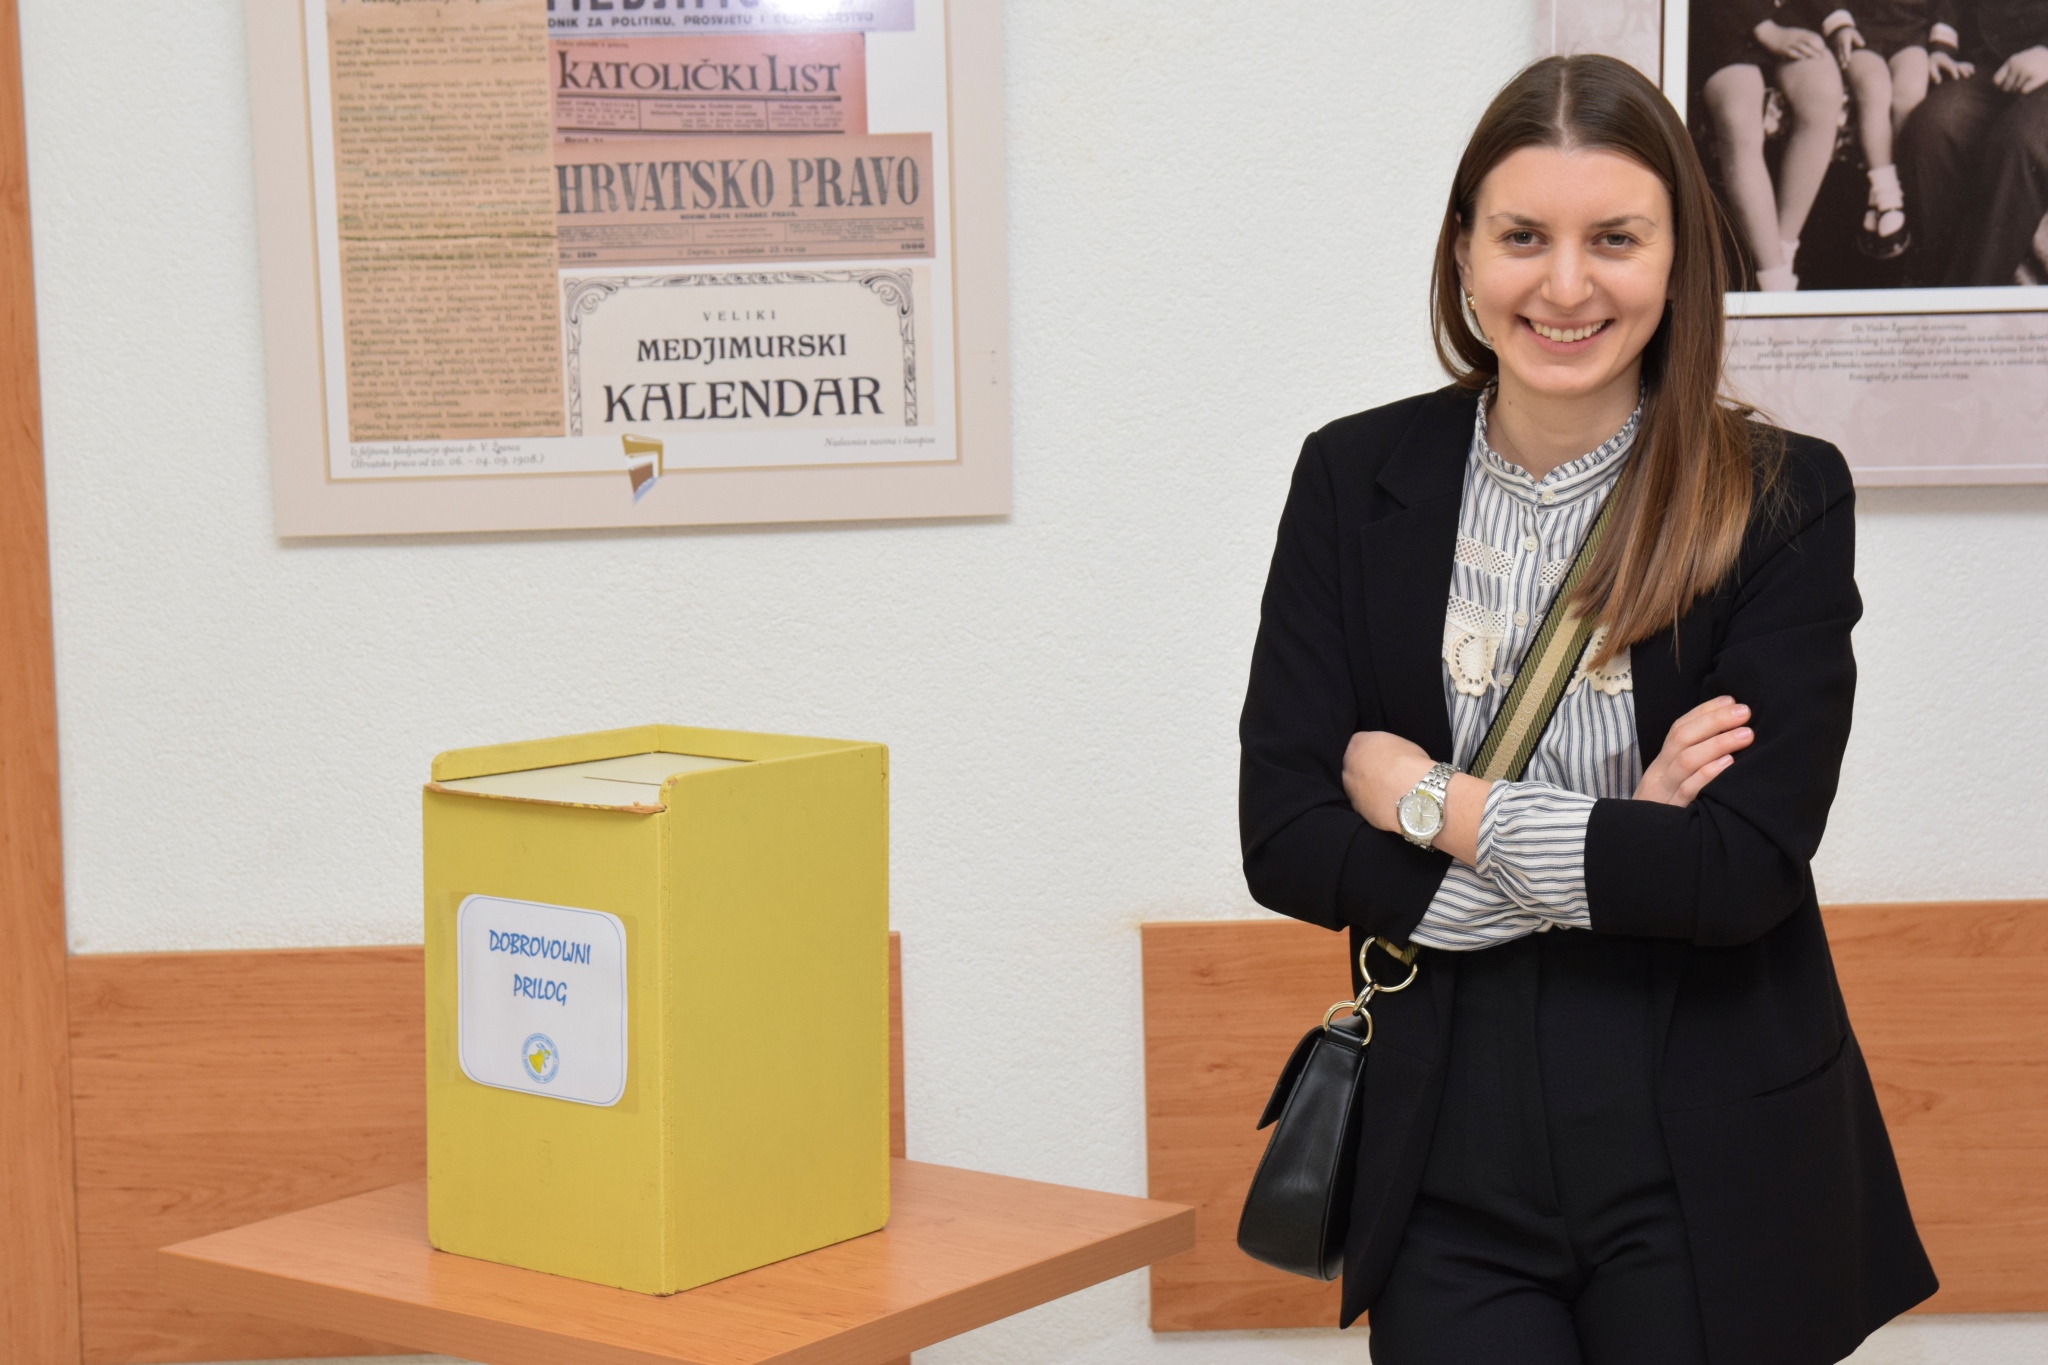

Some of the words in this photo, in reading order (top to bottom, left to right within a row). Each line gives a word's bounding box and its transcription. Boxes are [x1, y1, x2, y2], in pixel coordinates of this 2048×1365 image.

[588, 16, 603, 27] ZA
[611, 15, 675, 27] POLITIKU,
[684, 14, 750, 26] PROSVJETU
[557, 50, 759, 92] KATOLIČKI
[763, 54, 842, 93] LIST
[556, 159, 775, 214] HRVATSKO
[788, 156, 920, 208] PRAVO
[703, 310, 777, 322] VELIKI
[637, 334, 848, 364] MEDJIMURSKI
[604, 376, 885, 423] KALENDAR
[489, 929, 591, 965] DOBROVOLJNI
[513, 973, 568, 1006] PRILOG
